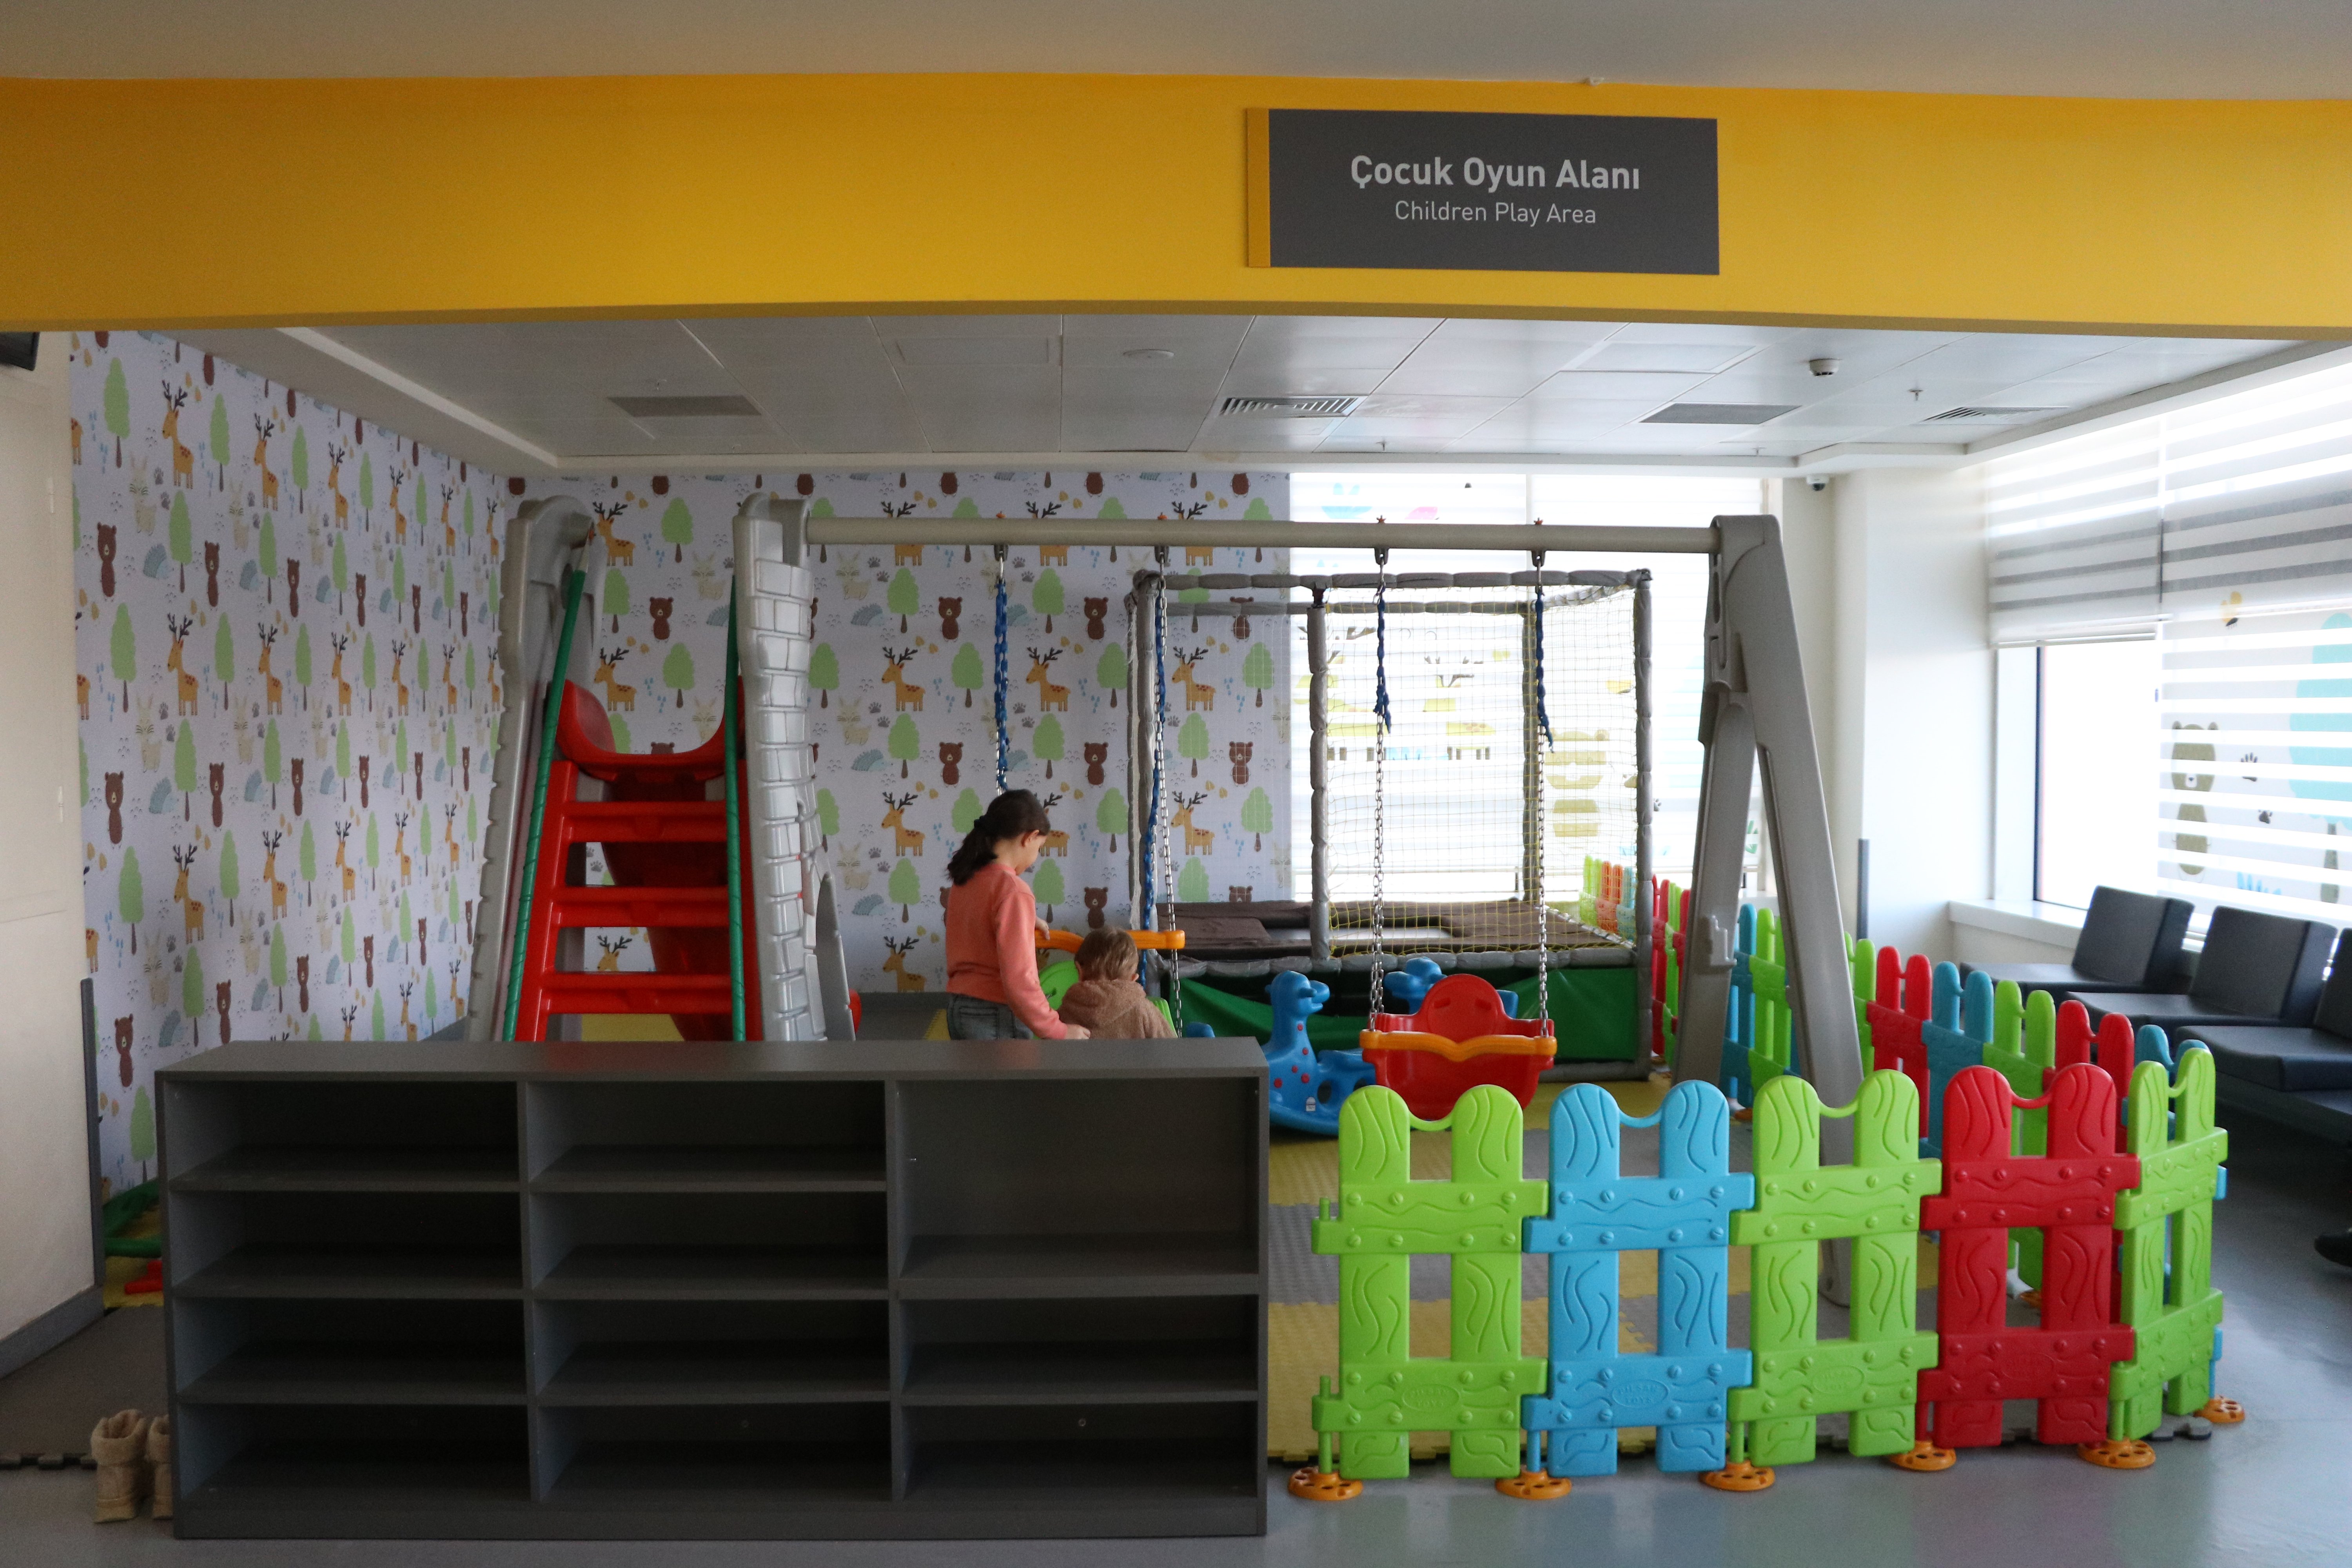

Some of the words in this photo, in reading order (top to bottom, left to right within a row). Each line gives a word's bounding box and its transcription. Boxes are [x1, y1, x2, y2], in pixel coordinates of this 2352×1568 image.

[1350, 155, 1454, 189] Çocuk
[1463, 157, 1546, 193] Oyun
[1555, 159, 1640, 190] Alanı
[1395, 200, 1487, 221] Children
[1495, 201, 1541, 228] Play
[1546, 203, 1596, 224] Area
